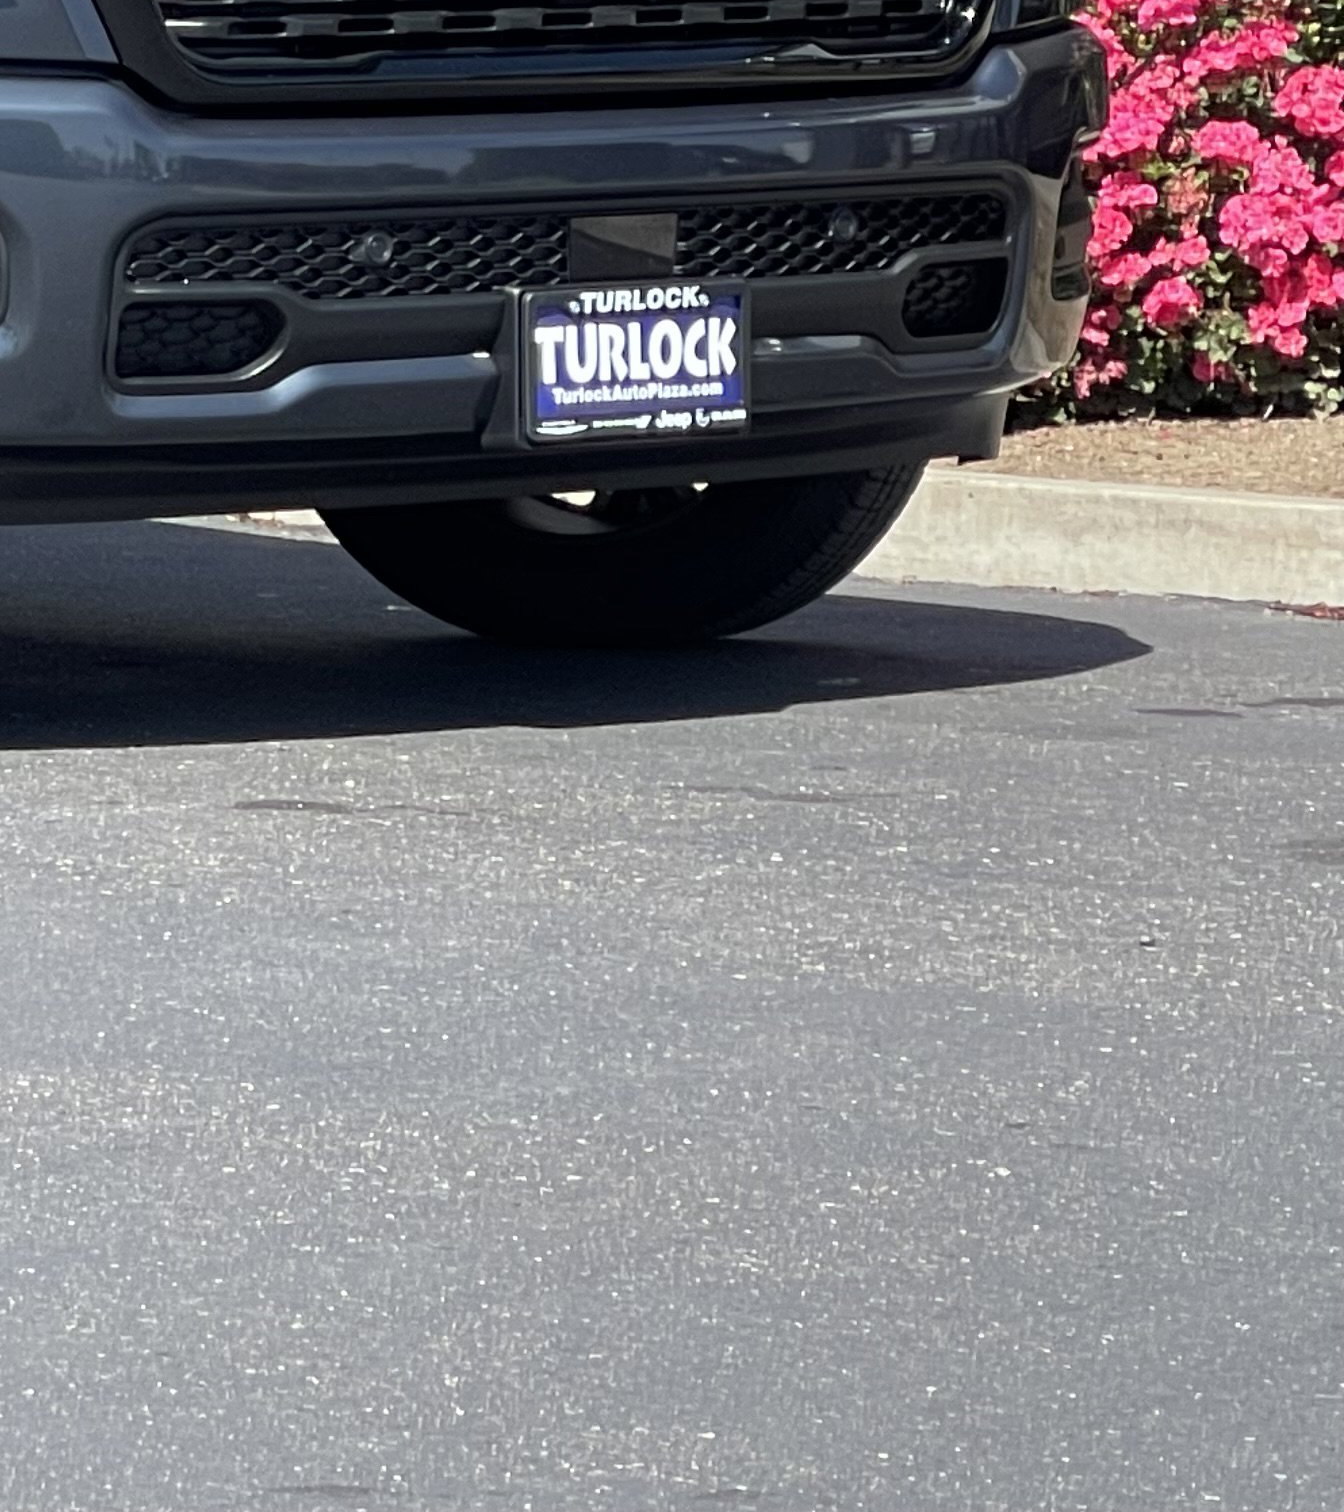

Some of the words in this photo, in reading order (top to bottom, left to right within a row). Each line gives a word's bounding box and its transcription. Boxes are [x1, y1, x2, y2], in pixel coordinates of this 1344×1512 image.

[580, 285, 701, 314] TURLOCK
[534, 317, 737, 385] TURLOCK
[551, 382, 724, 405] TurlockAutoPlaza.com
